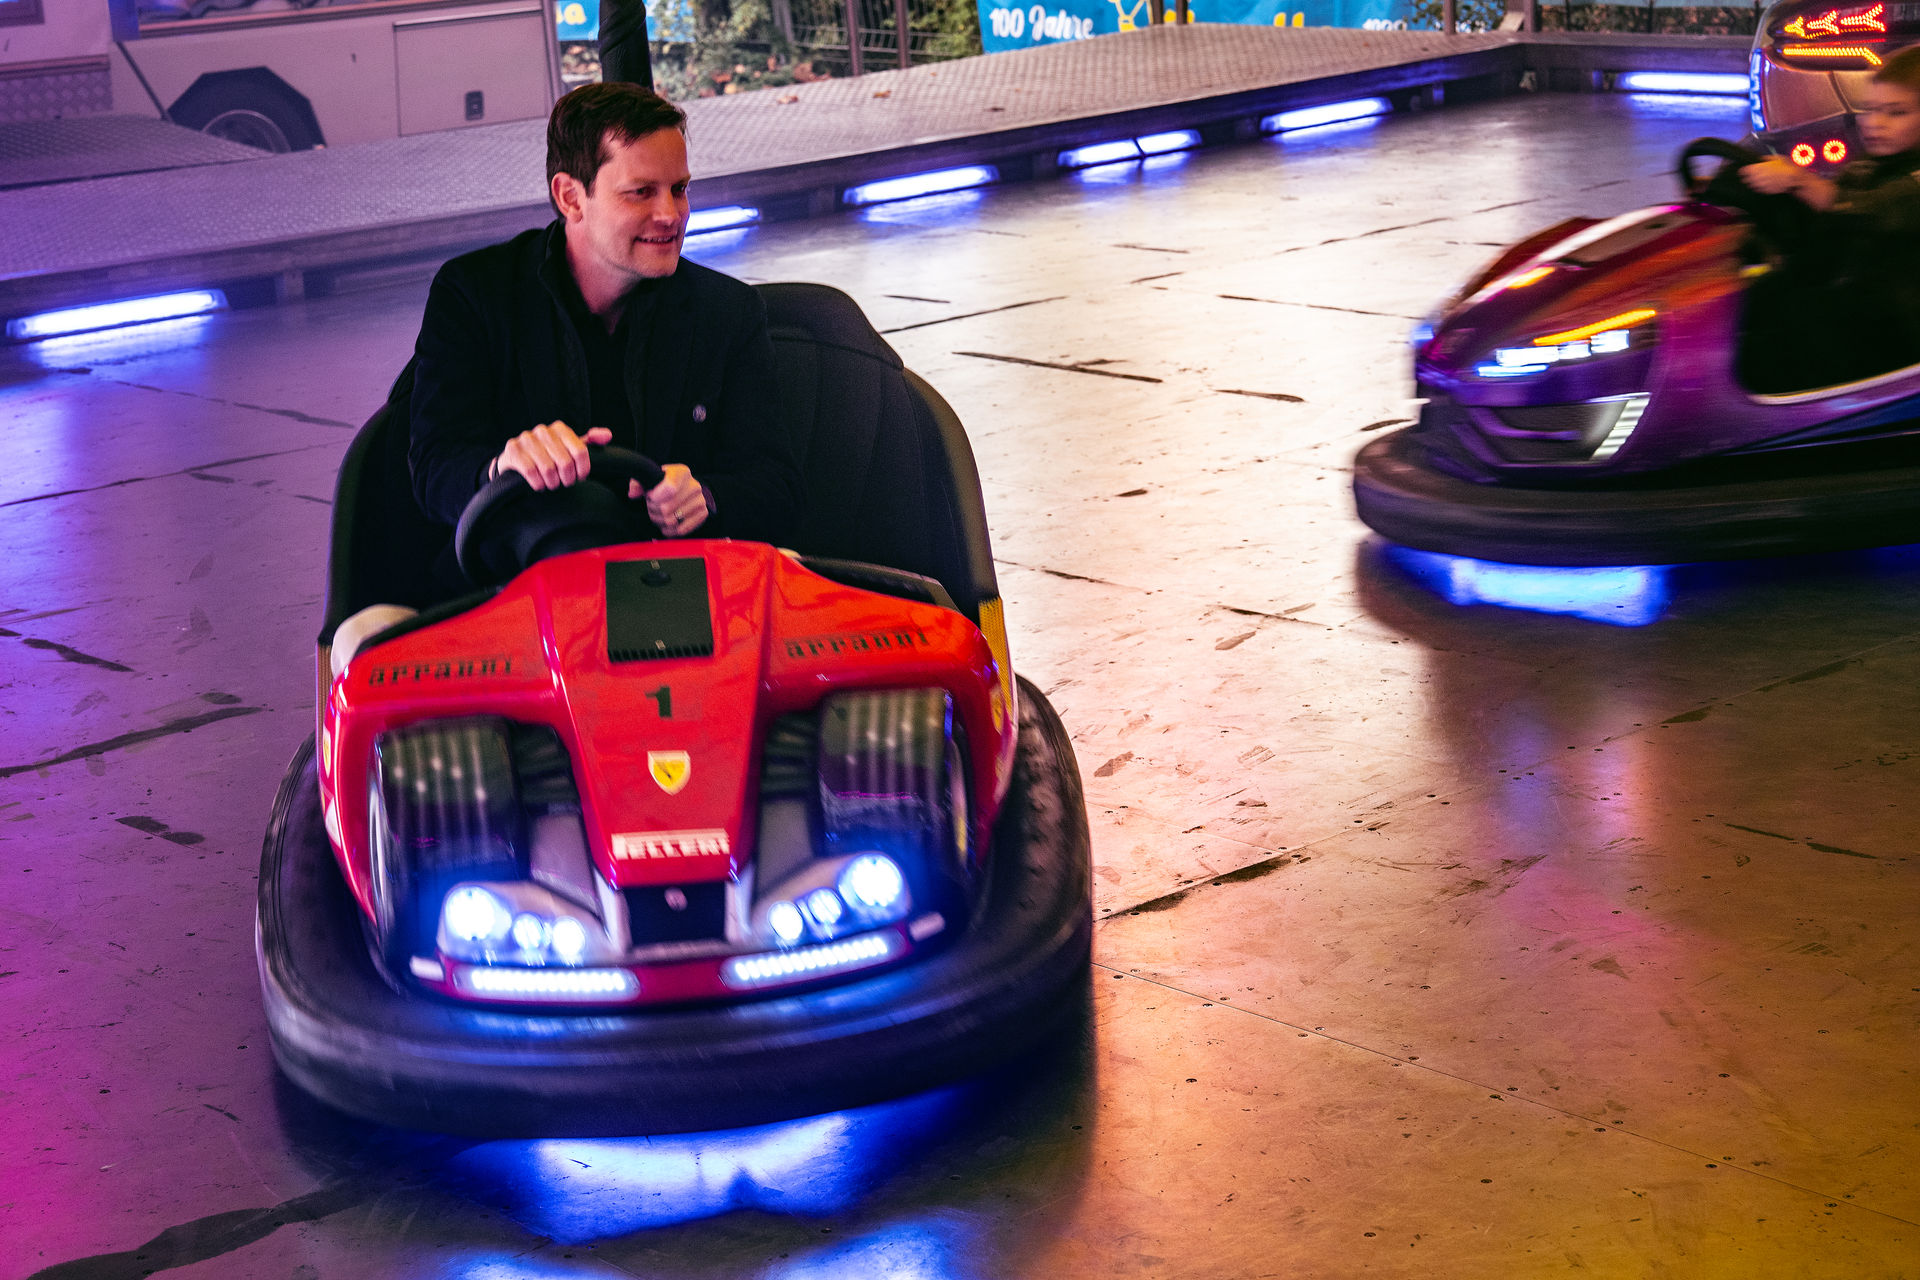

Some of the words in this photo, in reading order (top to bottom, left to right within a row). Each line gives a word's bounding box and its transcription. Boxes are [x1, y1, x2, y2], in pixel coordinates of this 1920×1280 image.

[989, 7, 1025, 38] 100
[1029, 5, 1095, 40] Jahre
[644, 684, 672, 718] 1
